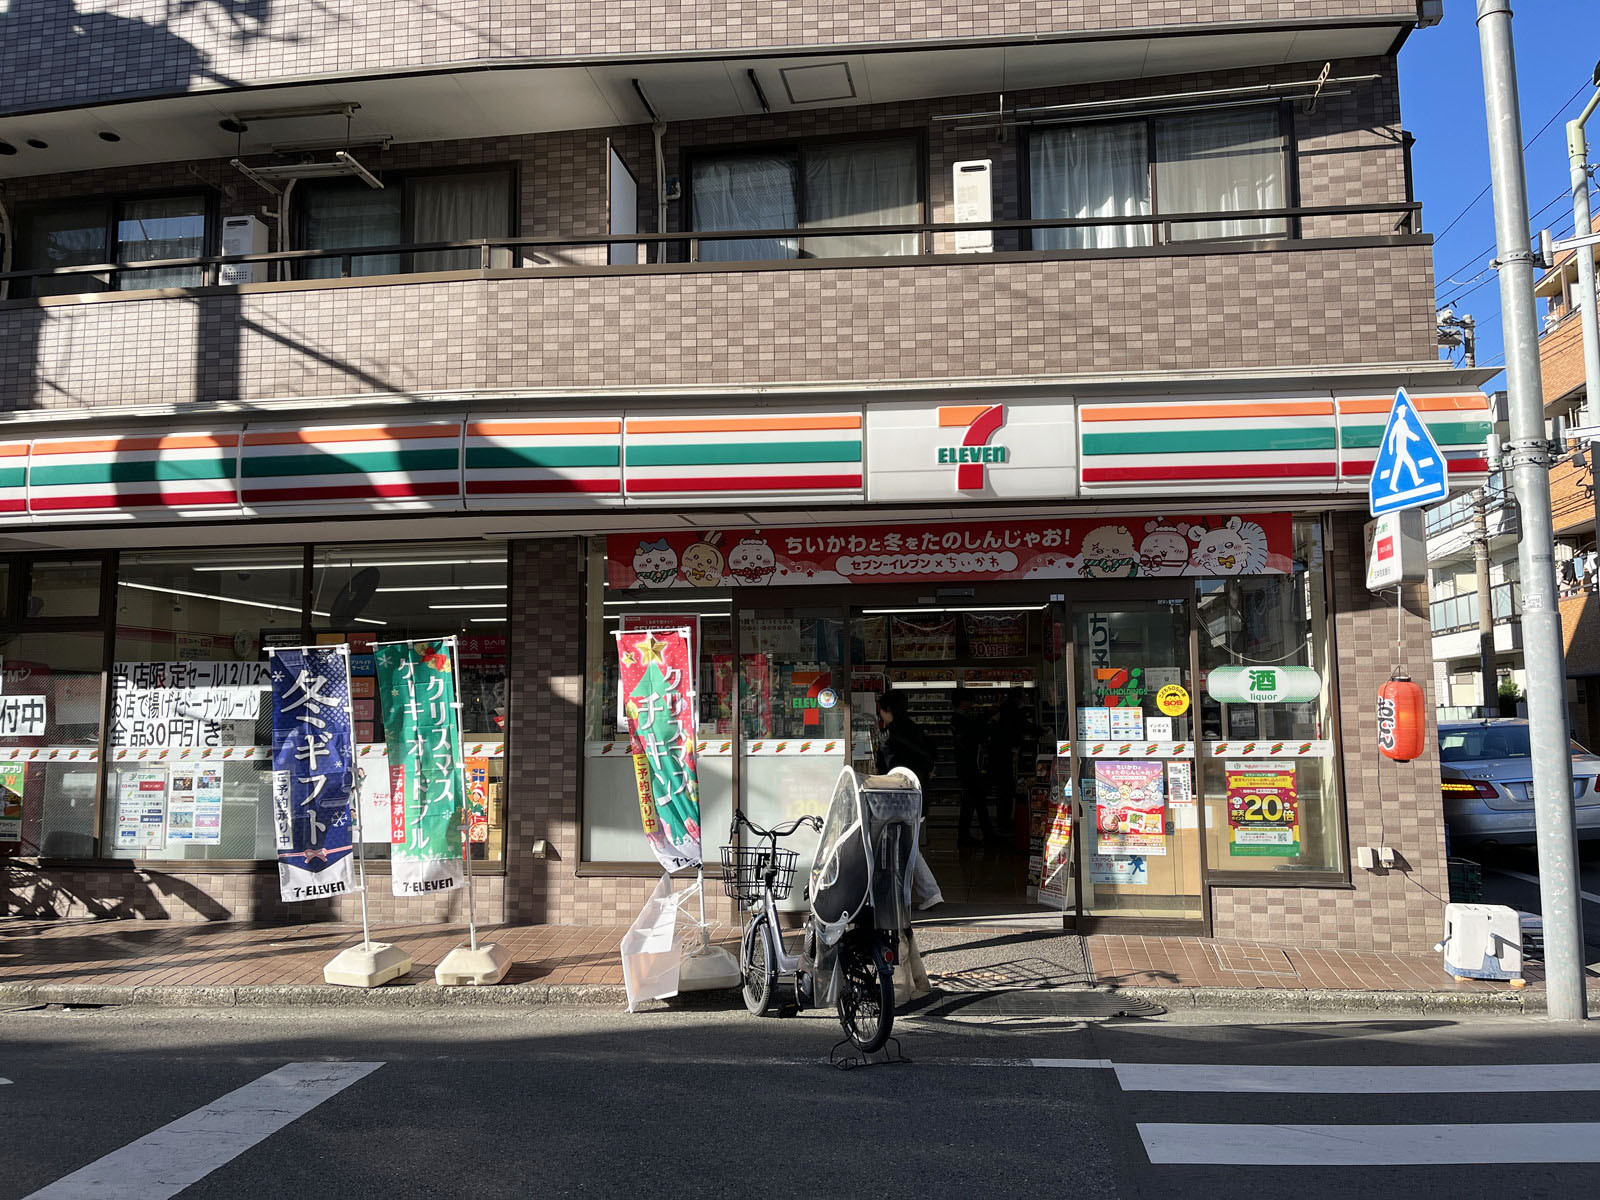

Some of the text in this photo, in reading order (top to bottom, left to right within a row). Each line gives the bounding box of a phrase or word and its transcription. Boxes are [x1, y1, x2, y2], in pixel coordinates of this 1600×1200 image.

[785, 528, 1071, 555] ちいかわと冬をたのしんじゃお!
[1248, 669, 1277, 692] 酒
[1250, 693, 1278, 702] liquor
[111, 718, 221, 747] 全品30円引き
[280, 669, 343, 846] 冬ギフト
[398, 658, 431, 851] ケーキ・オードブル
[427, 675, 455, 803] クリスマス
[637, 691, 673, 807] チキン
[663, 666, 692, 796] クリスマス
[636, 754, 656, 830] ご予約承り中
[1243, 794, 1284, 821] 20
